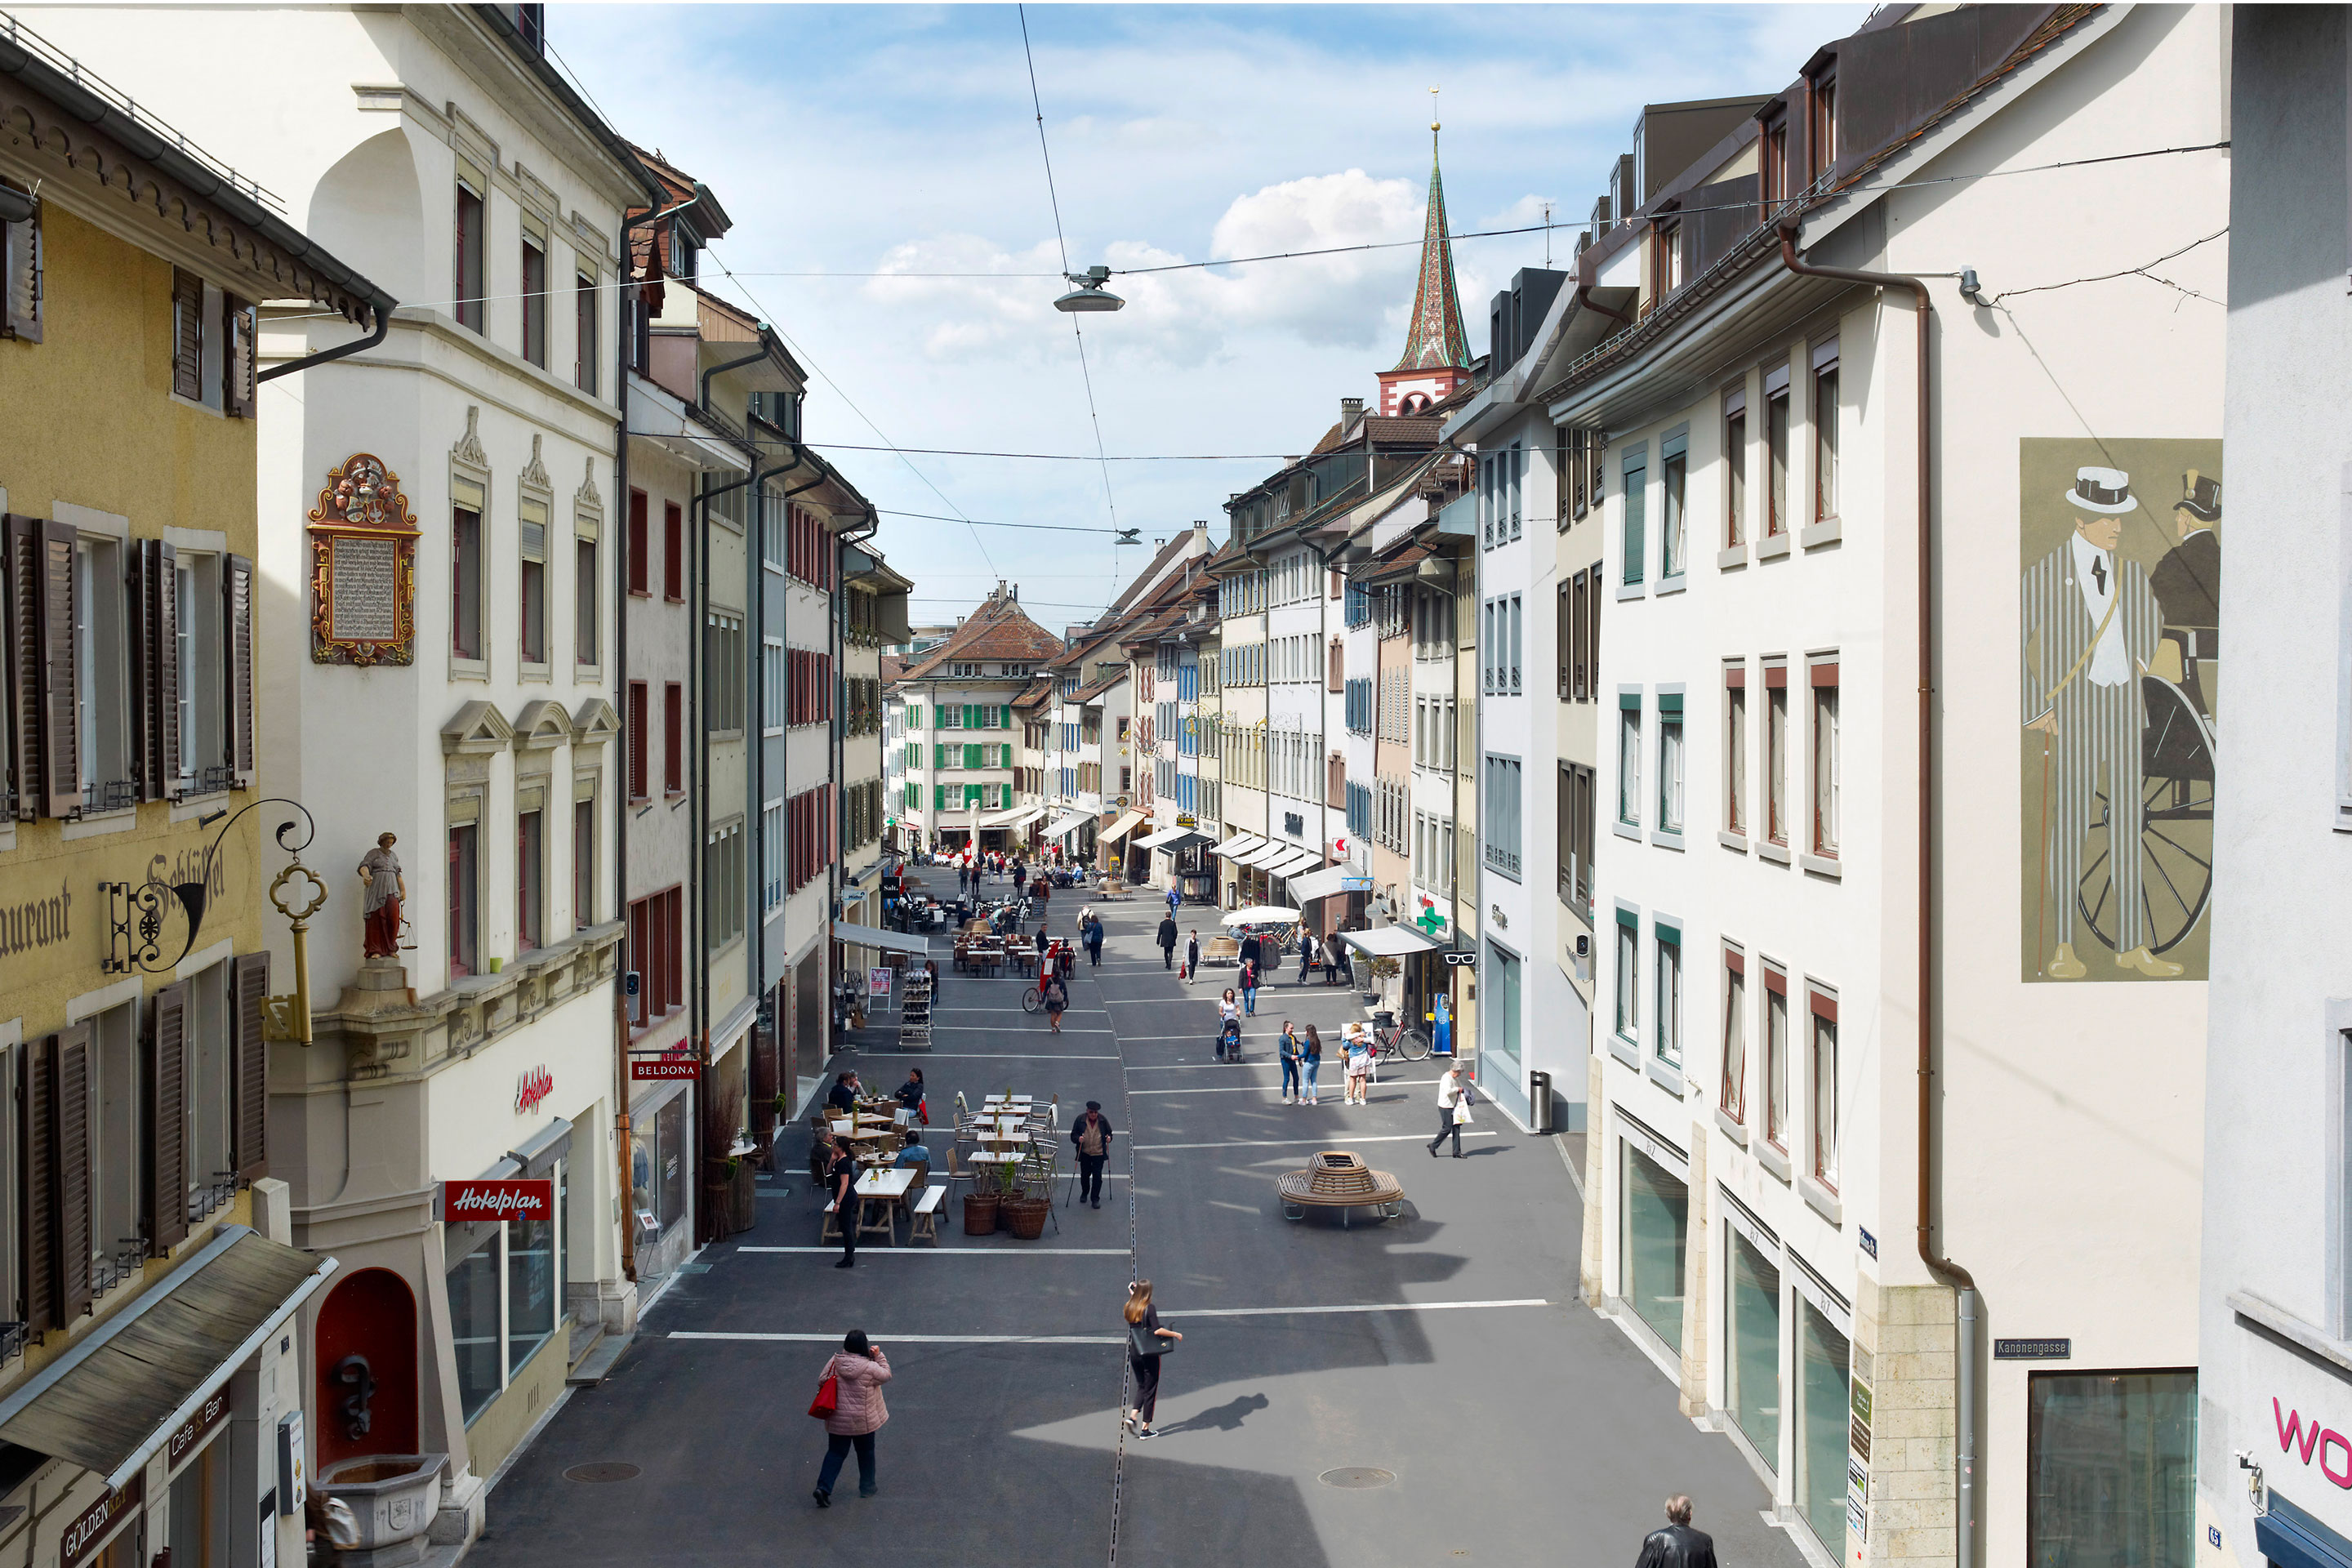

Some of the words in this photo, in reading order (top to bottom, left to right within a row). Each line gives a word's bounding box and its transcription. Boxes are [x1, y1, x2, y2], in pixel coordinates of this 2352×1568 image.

[638, 1066, 694, 1076] BELDONA
[519, 1064, 553, 1116] Hotelplan
[453, 1187, 543, 1216] Hotelplan
[1998, 1340, 2066, 1356] Kanonengasse
[172, 1423, 194, 1456] Cafe
[195, 1411, 203, 1432] &
[205, 1396, 223, 1423] Bar
[2209, 1529, 2220, 1546] 65
